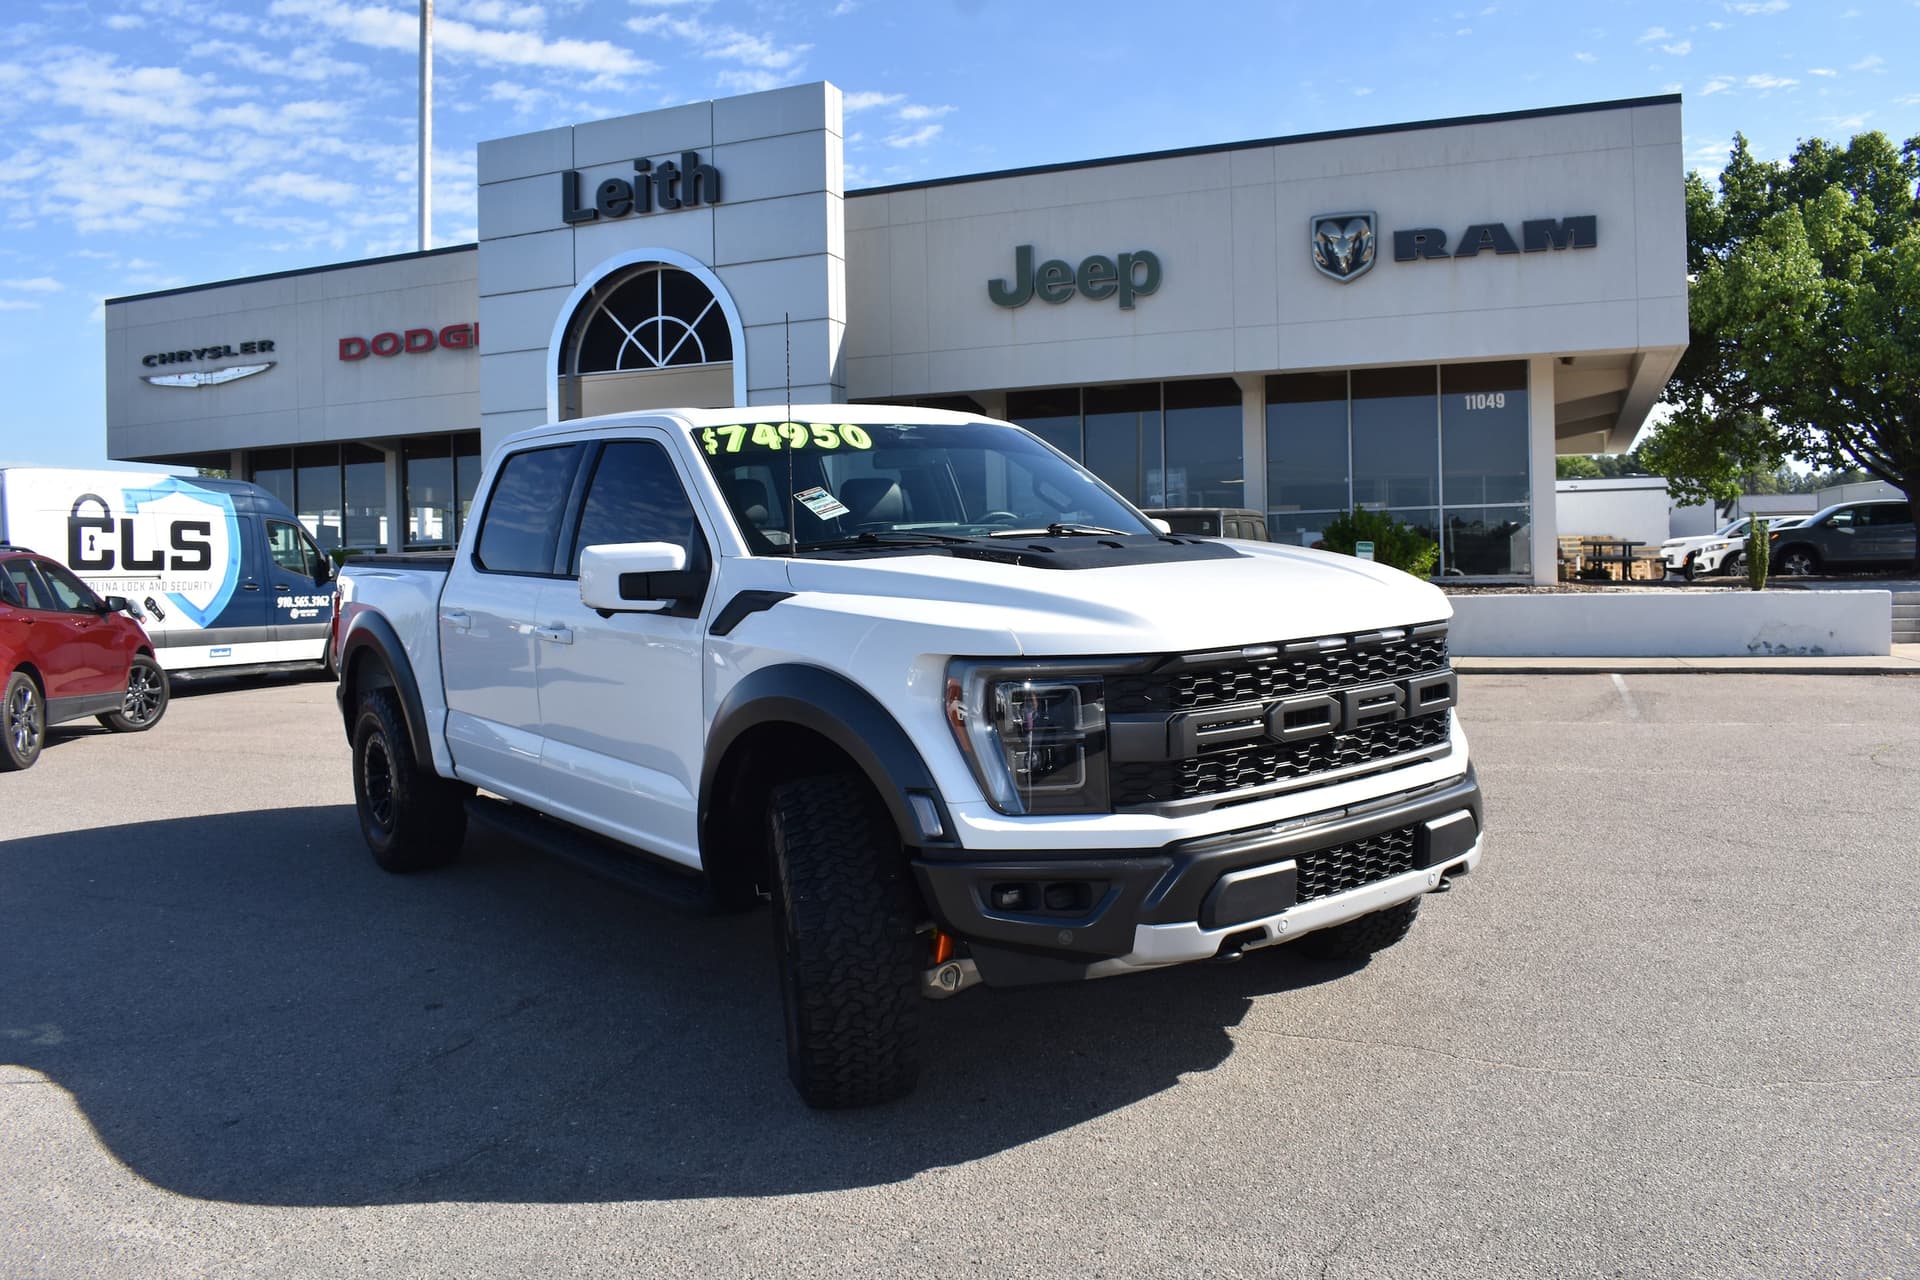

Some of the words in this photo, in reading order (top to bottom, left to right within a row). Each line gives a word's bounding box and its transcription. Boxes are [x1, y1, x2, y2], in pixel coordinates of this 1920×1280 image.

[562, 151, 720, 224] Leith
[1393, 215, 1597, 262] RAM
[987, 245, 1162, 310] Jeep
[142, 339, 275, 368] CHRYSLER
[1464, 392, 1505, 410] 11049
[702, 421, 872, 455] $74950
[67, 512, 211, 571] CLS
[87, 581, 118, 592] OLINA
[122, 581, 146, 592] LOCK
[149, 581, 167, 592] AND
[170, 580, 213, 592] SECURITY
[1166, 669, 1457, 757] FORD
